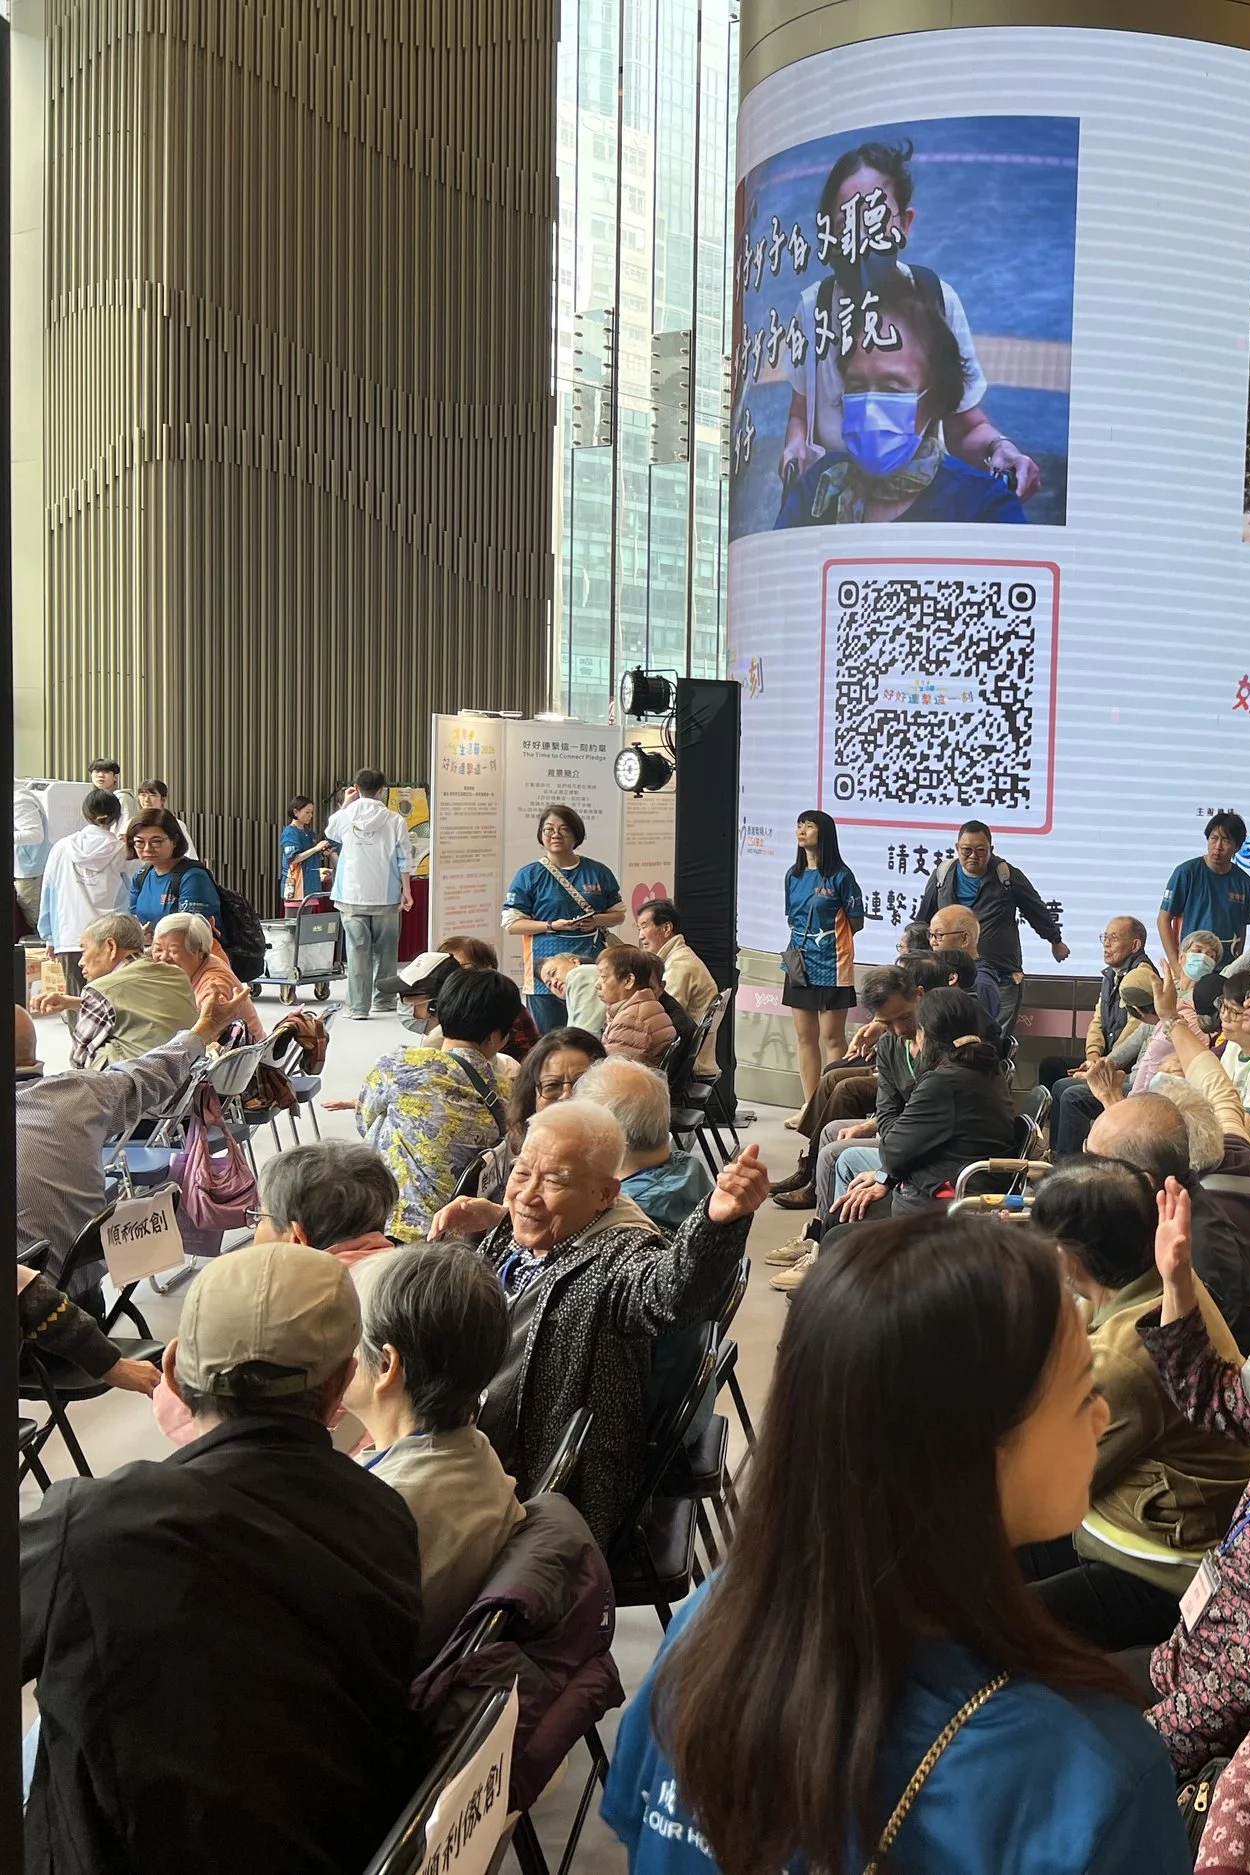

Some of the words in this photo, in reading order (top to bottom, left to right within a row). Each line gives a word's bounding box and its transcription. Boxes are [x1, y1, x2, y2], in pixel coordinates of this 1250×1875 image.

[522, 741, 606, 752] 好好連繫這一刻約章
[648, 1810, 683, 1841] OUR
